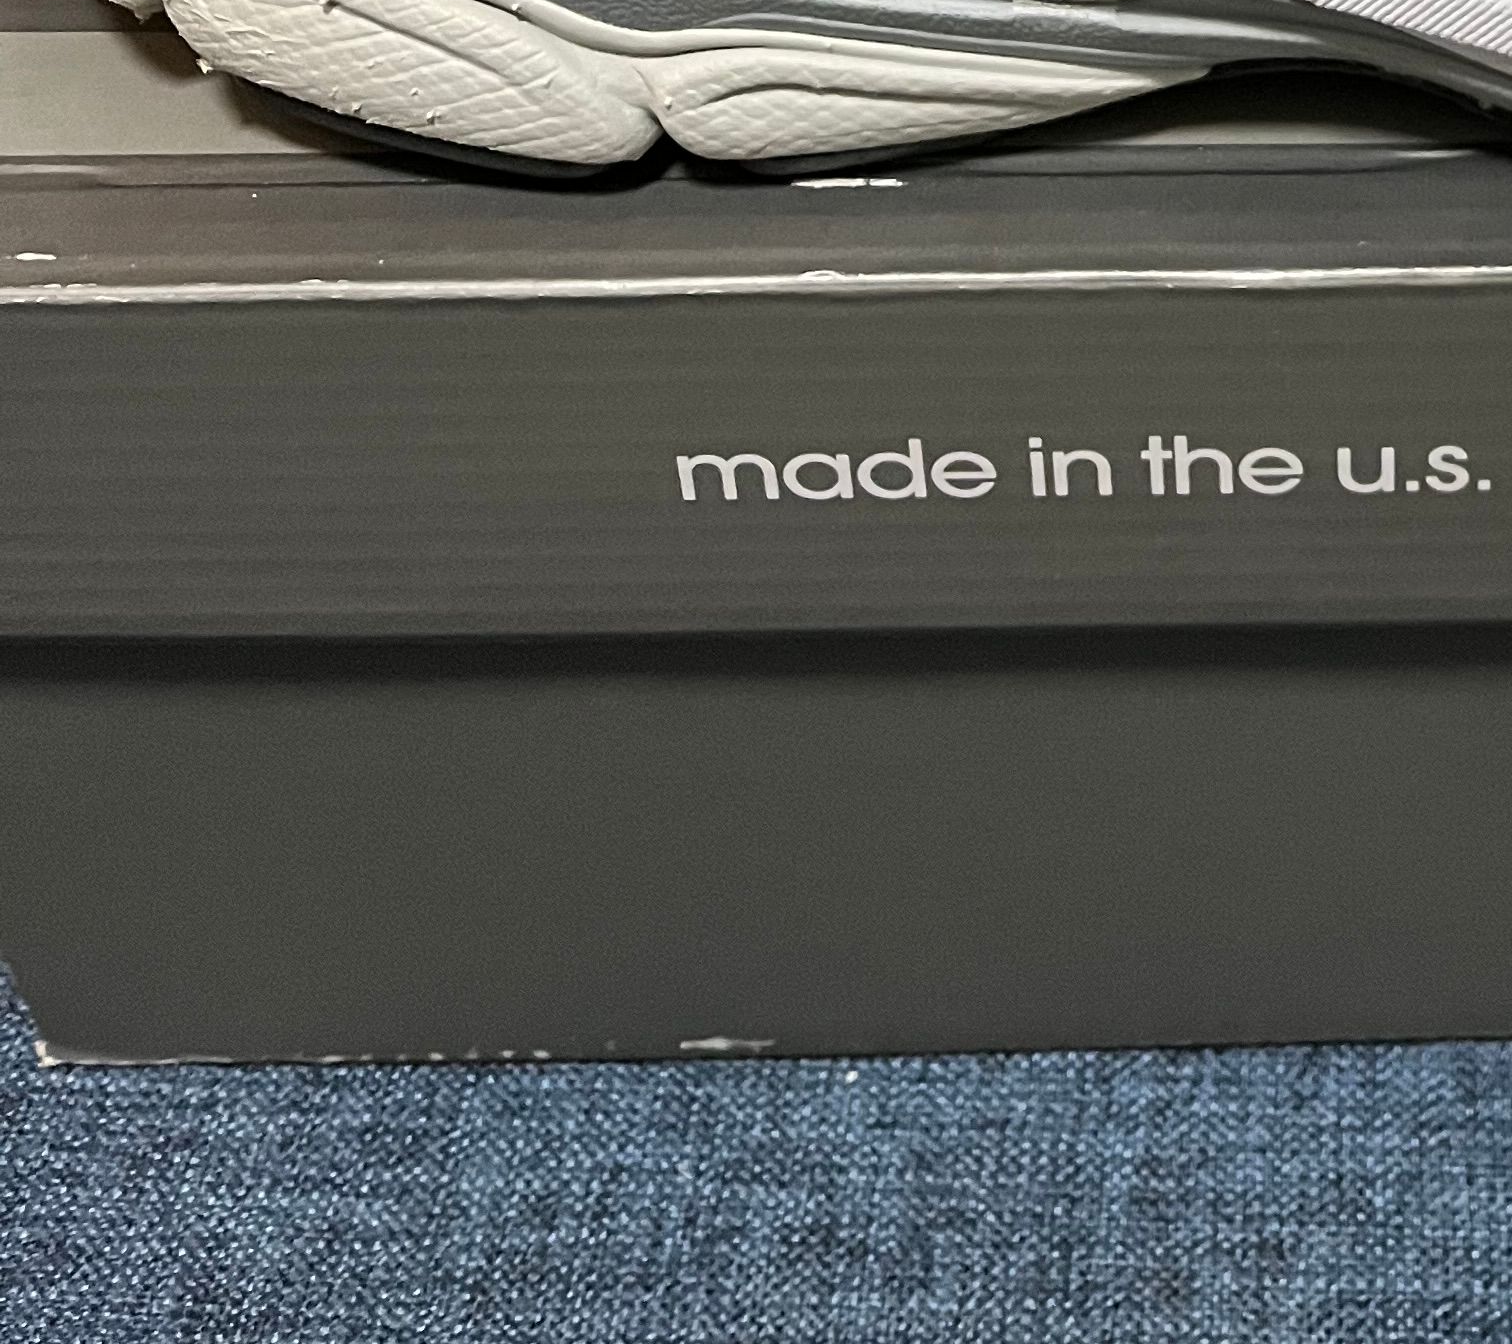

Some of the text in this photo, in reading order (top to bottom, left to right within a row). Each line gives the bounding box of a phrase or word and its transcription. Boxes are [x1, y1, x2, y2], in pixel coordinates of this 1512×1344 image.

[675, 436, 998, 502] made
[1028, 435, 1114, 498] in
[1140, 434, 1305, 496] the
[1335, 444, 1493, 494] u.s.
